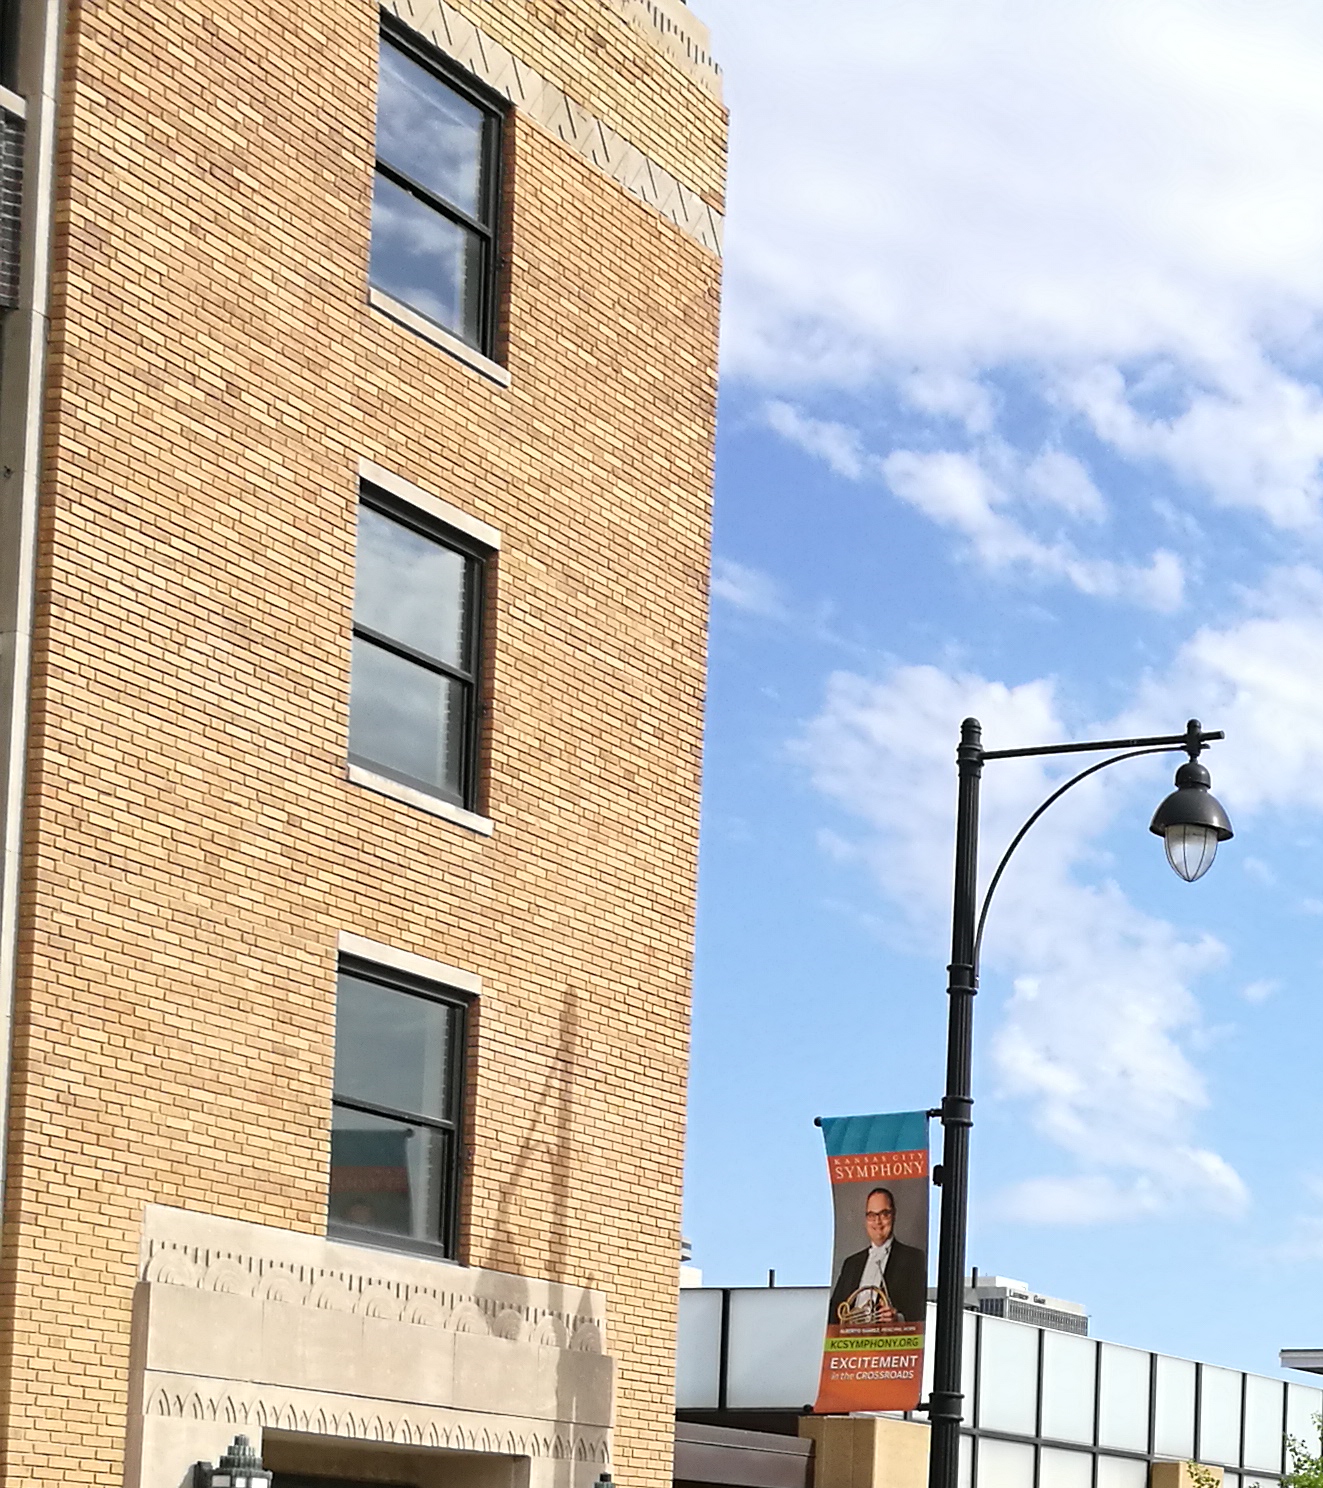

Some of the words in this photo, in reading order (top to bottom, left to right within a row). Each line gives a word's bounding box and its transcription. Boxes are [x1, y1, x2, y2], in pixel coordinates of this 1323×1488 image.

[833, 1155, 887, 1165] KANSAS
[892, 1152, 924, 1161] CITY
[834, 1161, 924, 1179] SYMPHONY
[830, 1337, 919, 1350] KCSYMPHONY.ORG
[830, 1355, 918, 1369] EXCITEMENT
[840, 1371, 855, 1380] the
[855, 1370, 914, 1380] CROSSROADS
